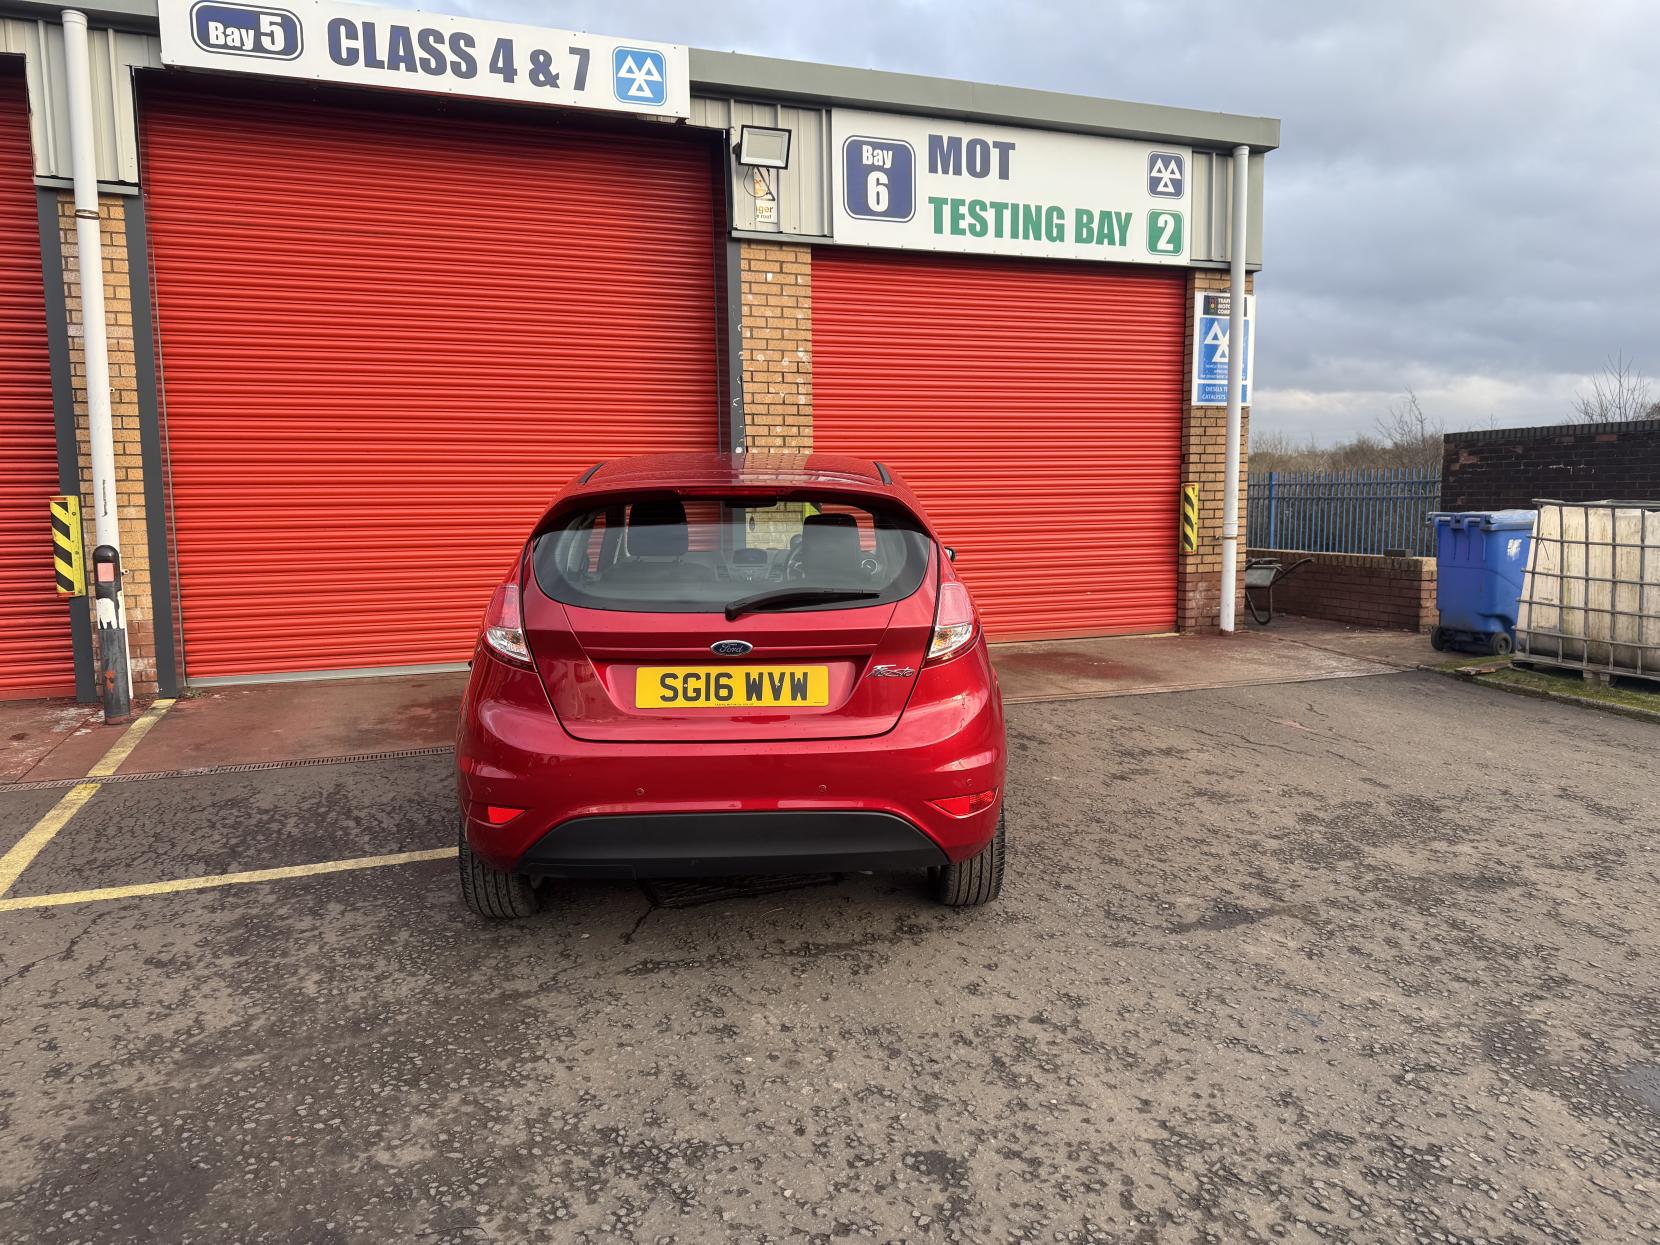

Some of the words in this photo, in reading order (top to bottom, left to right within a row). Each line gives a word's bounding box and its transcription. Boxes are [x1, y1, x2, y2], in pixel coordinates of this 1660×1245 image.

[208, 21, 254, 50] Bay
[259, 14, 285, 51] 5
[327, 17, 477, 79] CLASS
[489, 37, 518, 83] 4
[528, 49, 560, 88] &
[569, 46, 590, 91] 7
[862, 145, 894, 168] Bay
[928, 134, 1016, 180] MOT
[867, 171, 889, 212] 6
[928, 196, 1065, 243] TESTING
[1075, 208, 1133, 247] BAY
[1156, 214, 1175, 251] 2
[659, 672, 734, 702] SG16
[745, 671, 809, 702] WVW
